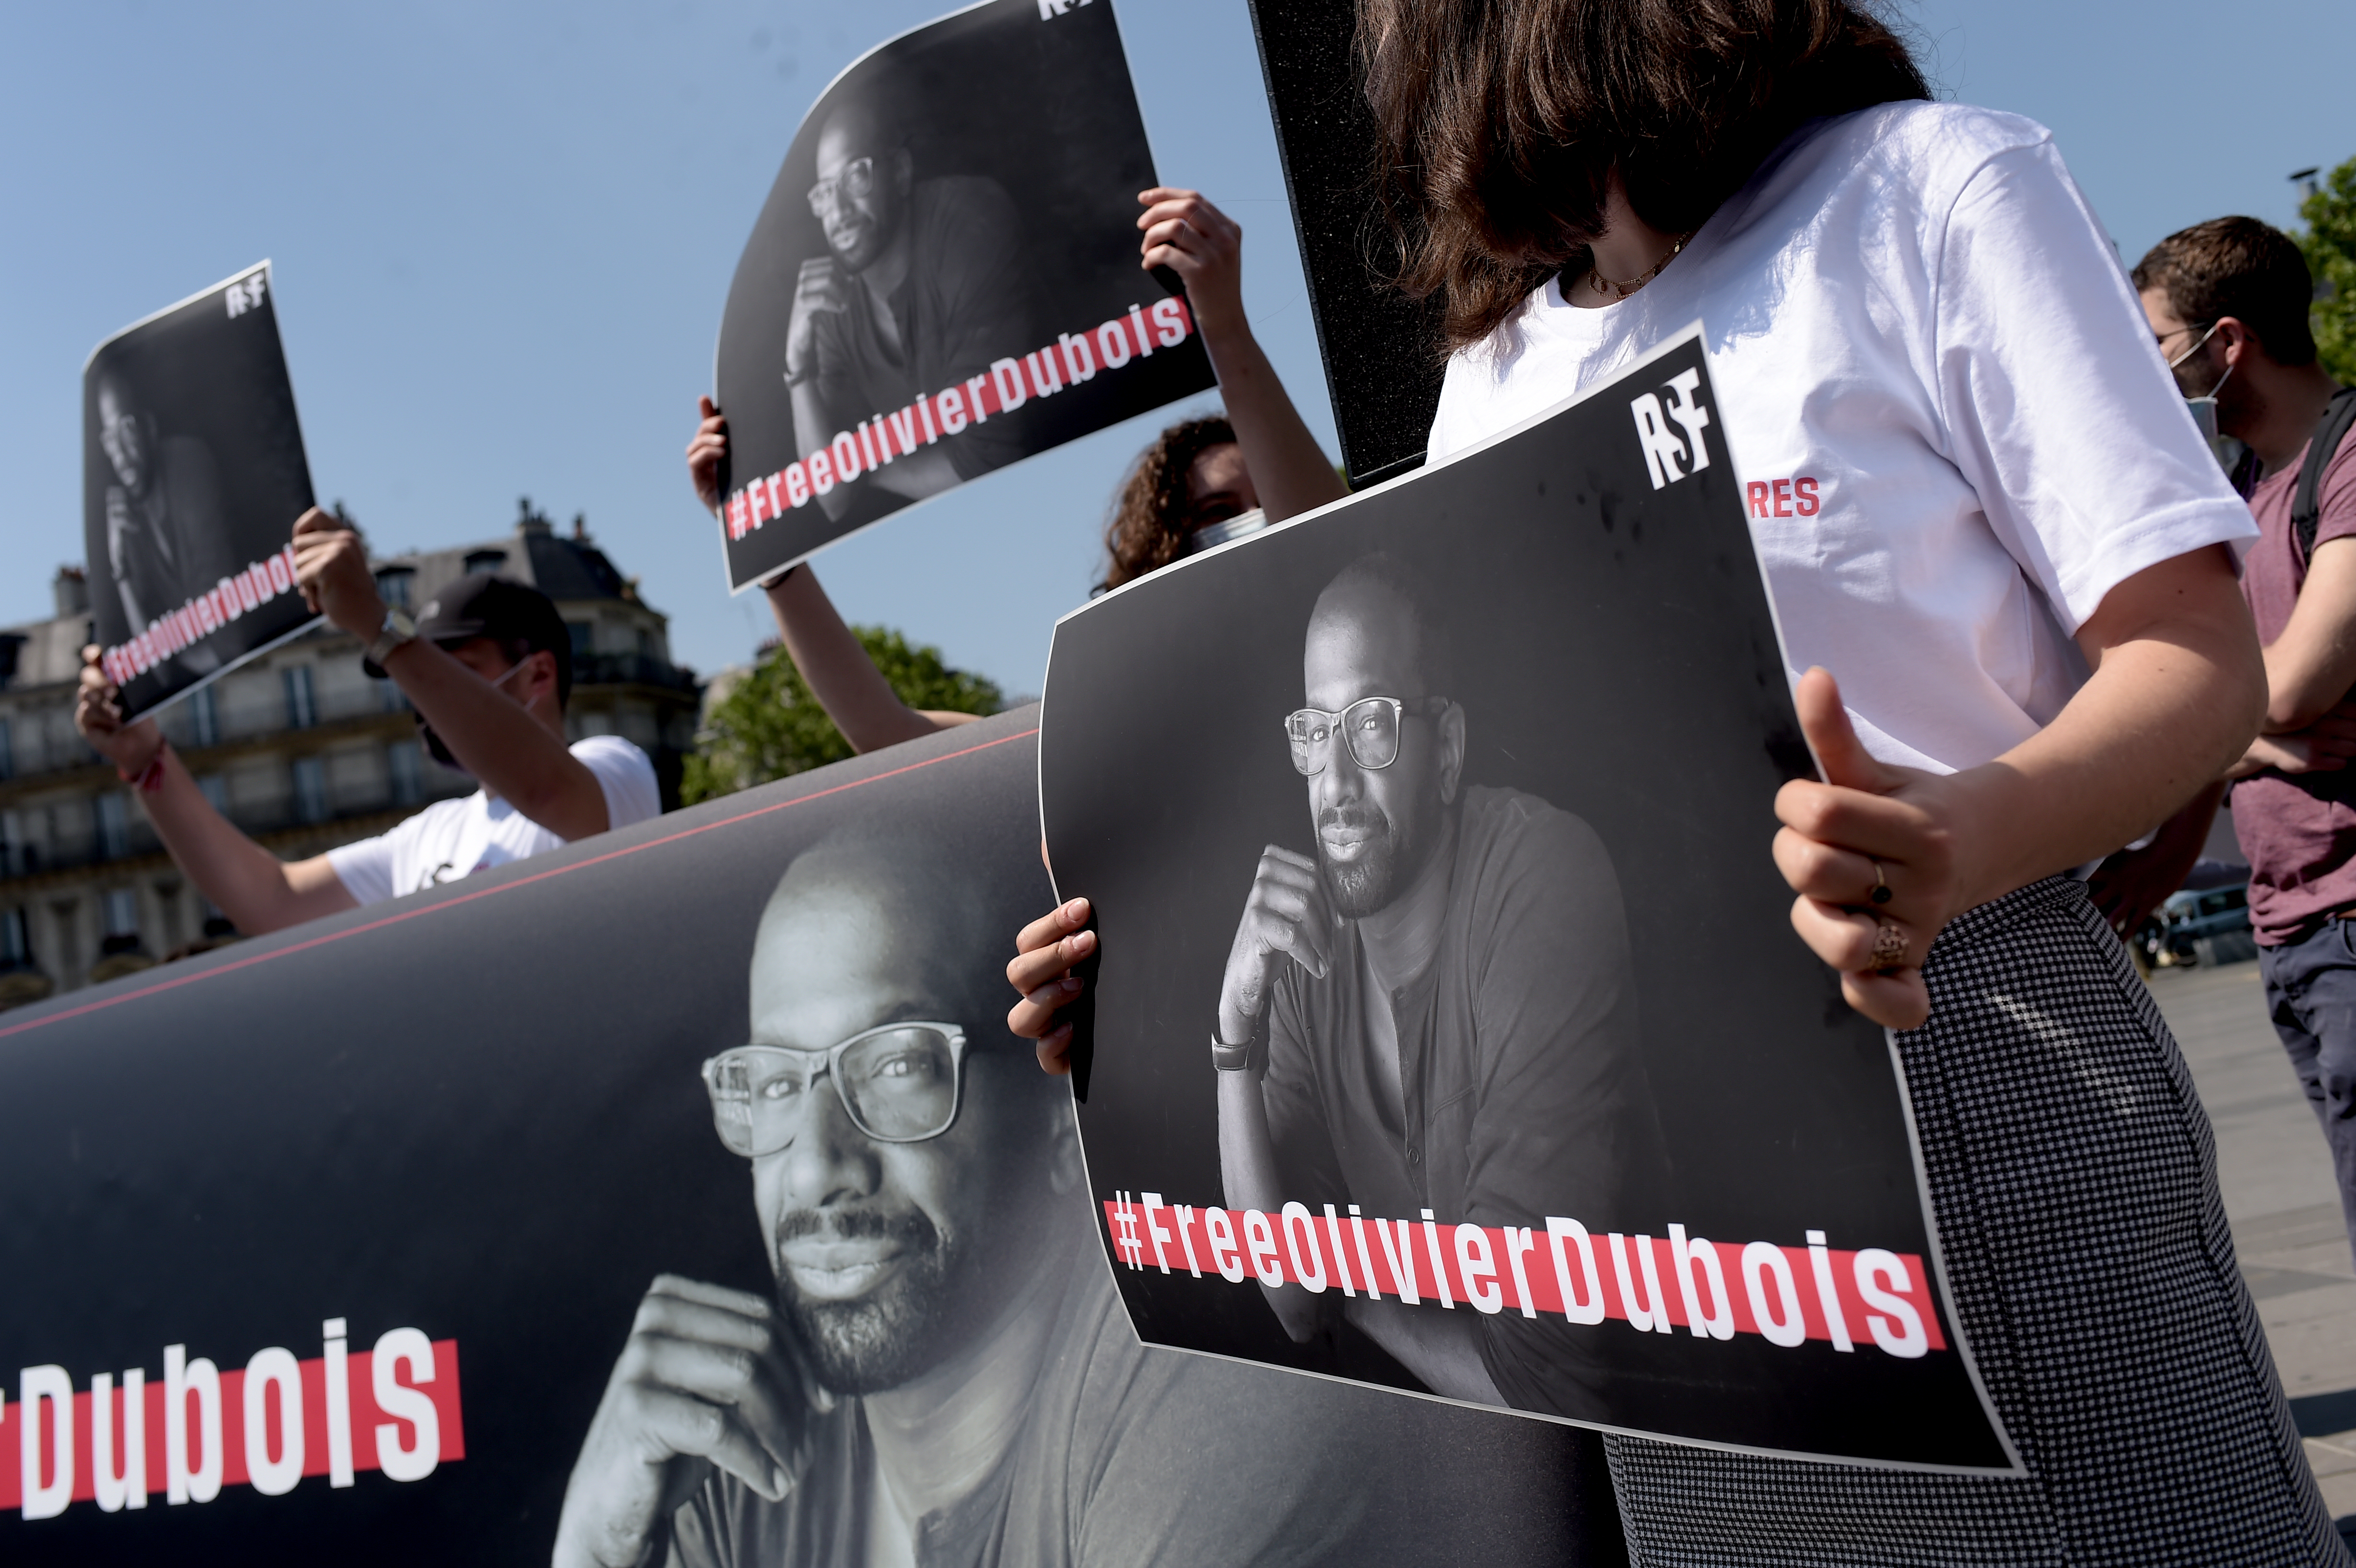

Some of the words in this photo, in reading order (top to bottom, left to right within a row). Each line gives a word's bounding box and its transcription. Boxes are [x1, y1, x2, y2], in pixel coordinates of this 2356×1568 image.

[730, 297, 1187, 540] #FreeOlivierDubois
[1630, 366, 1710, 490] RSF
[1114, 1190, 1929, 1359] #FreeOlivierDubois
[0, 1317, 441, 1521] Dubois
